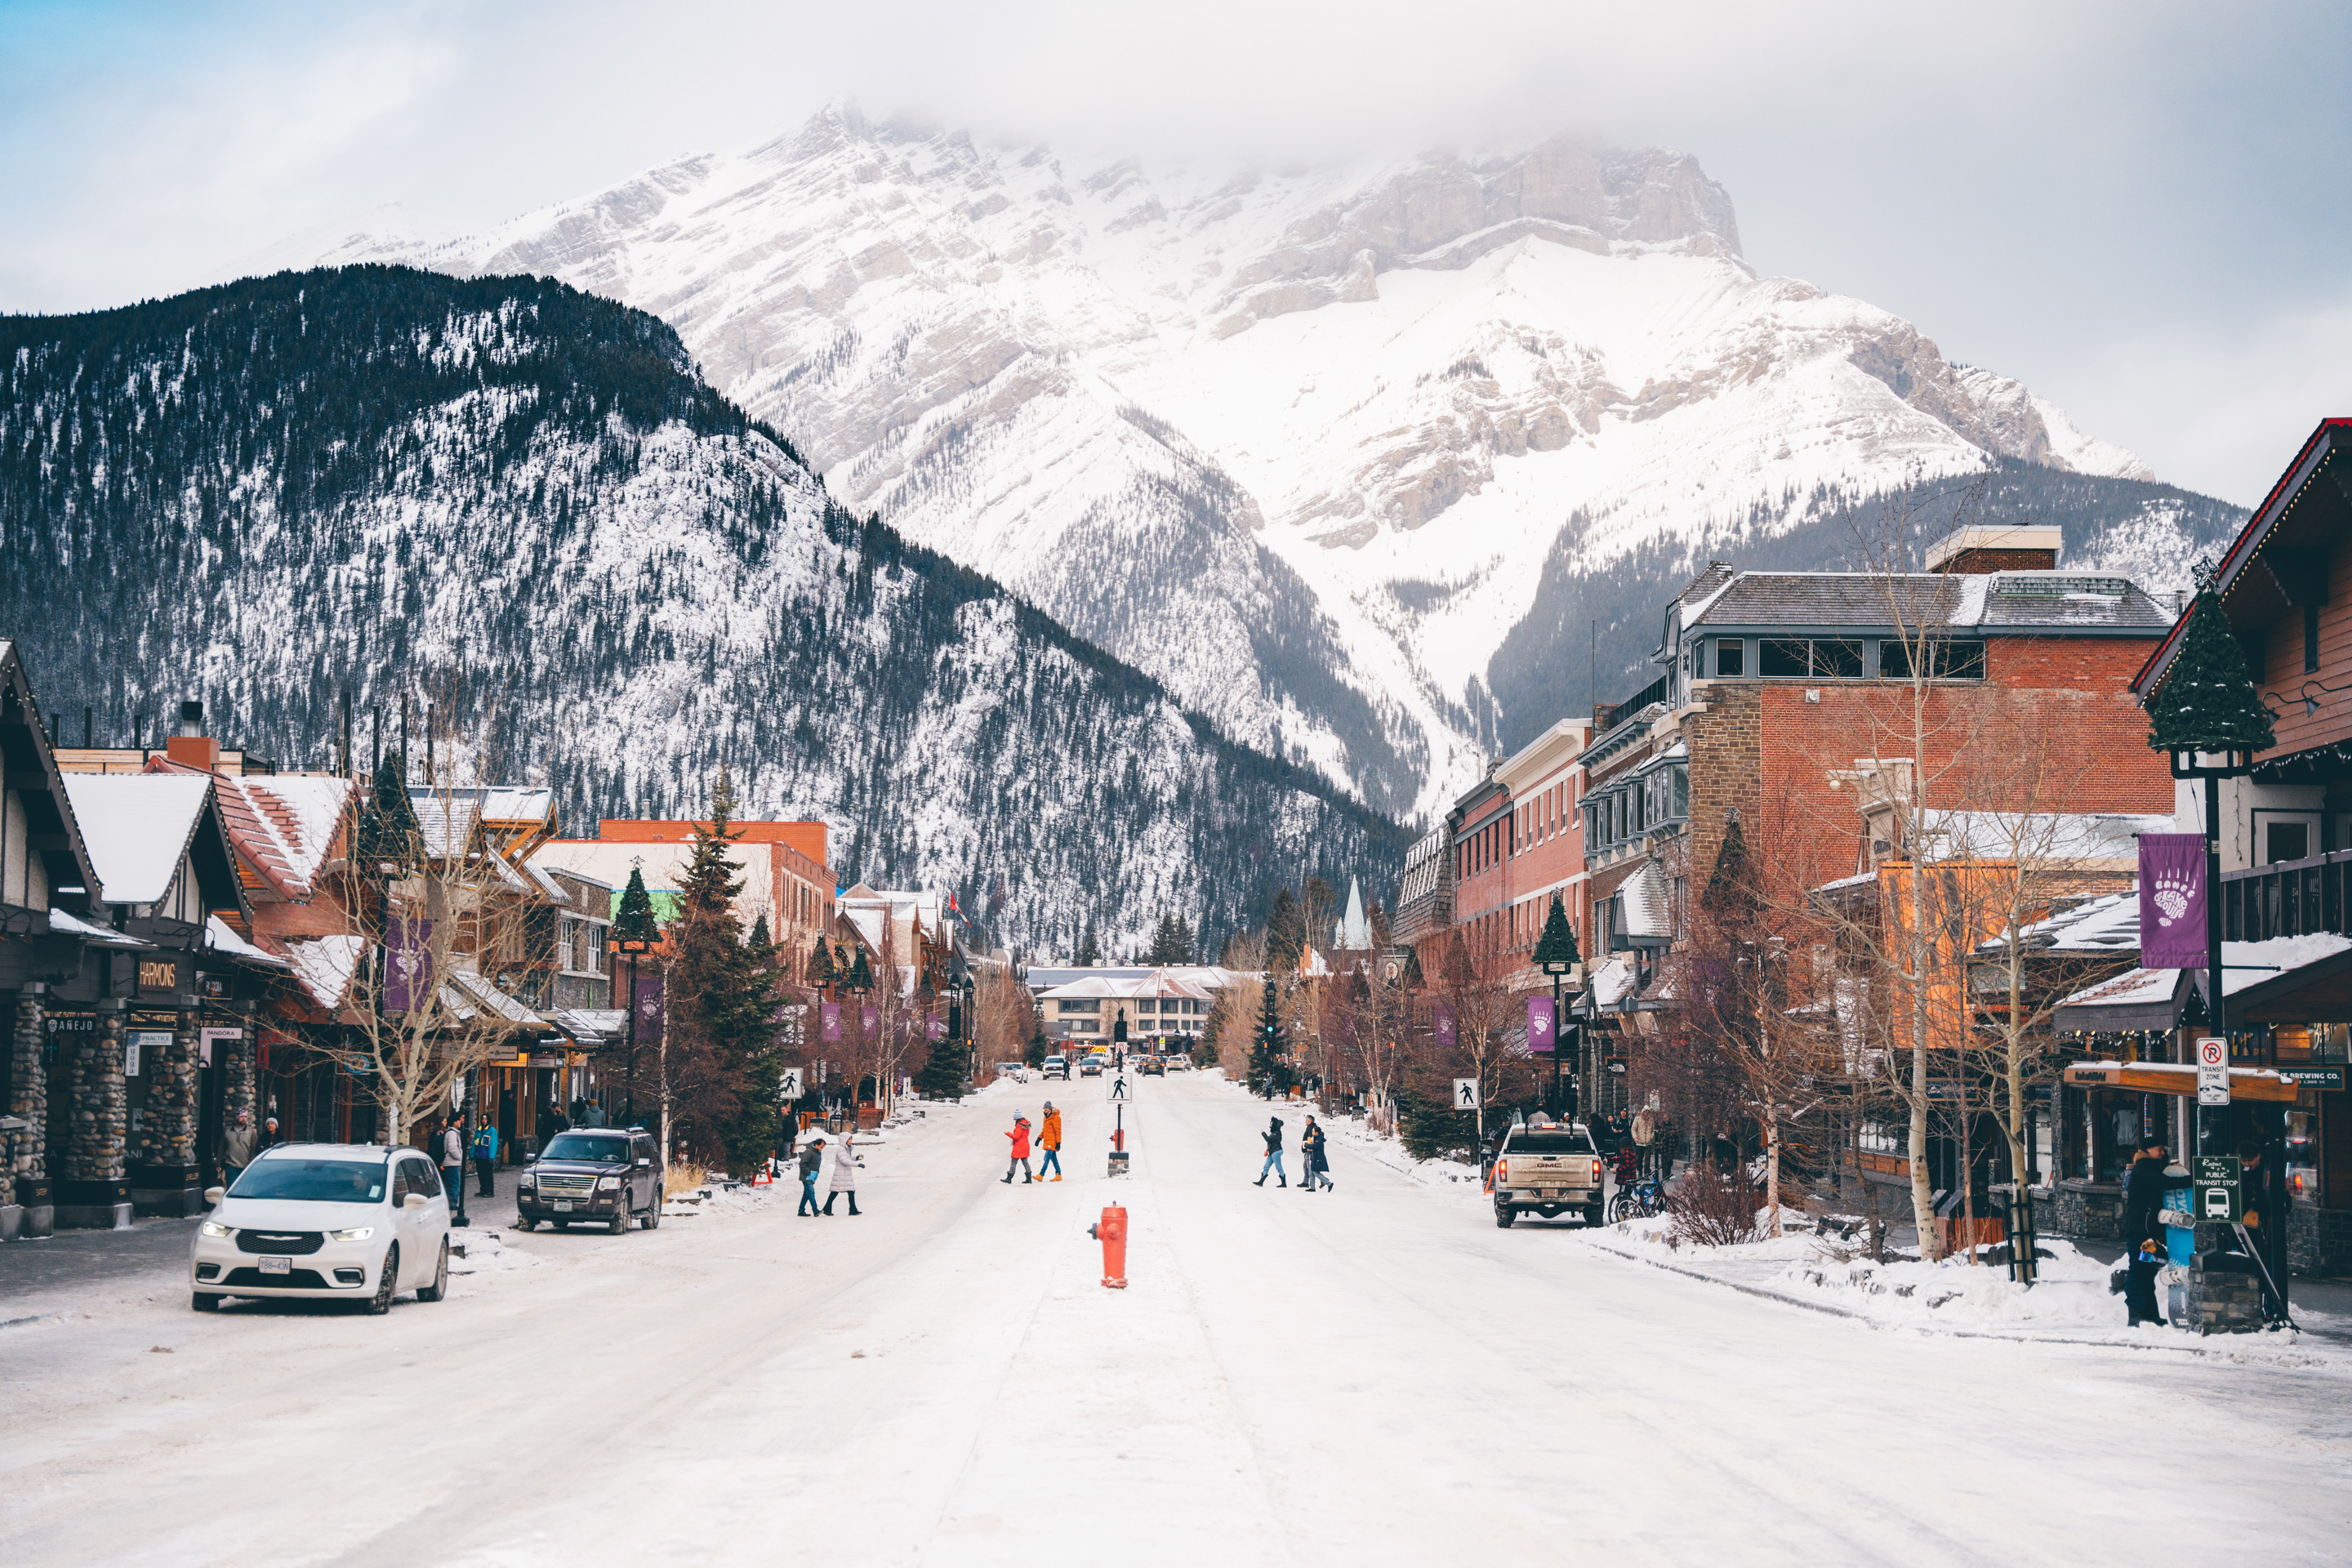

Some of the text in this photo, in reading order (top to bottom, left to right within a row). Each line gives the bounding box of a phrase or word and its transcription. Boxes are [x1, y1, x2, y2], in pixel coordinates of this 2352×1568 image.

[2155, 880, 2195, 898] BANFF
[140, 961, 176, 987] HARMONS
[59, 1020, 92, 1031] AÑEJO
